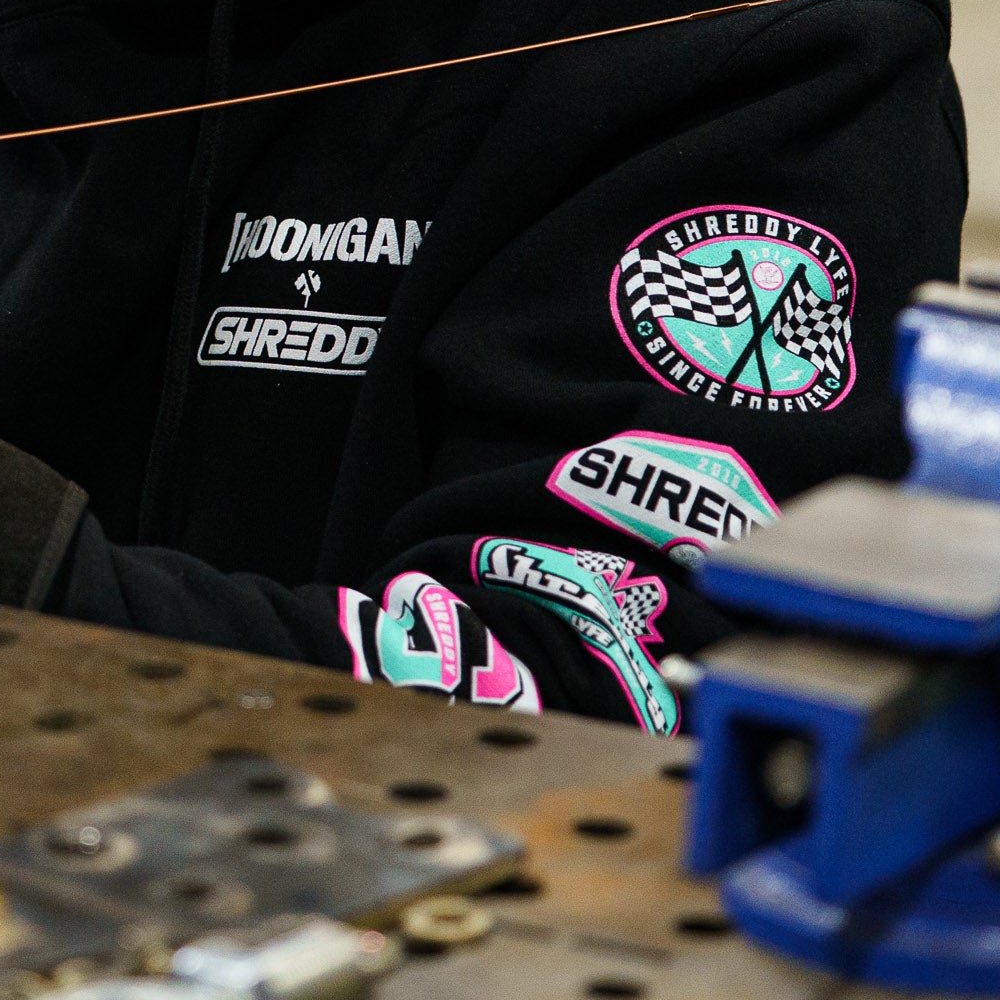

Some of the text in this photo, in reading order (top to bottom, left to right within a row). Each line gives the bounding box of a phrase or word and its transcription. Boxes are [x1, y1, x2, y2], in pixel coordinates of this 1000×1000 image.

[664, 213, 851, 301] SHREDDY LYFE
[207, 316, 382, 366] SHREDD
[645, 335, 722, 403] SINCE
[569, 447, 766, 542] SHRED
[425, 592, 457, 677] SHREDDY
